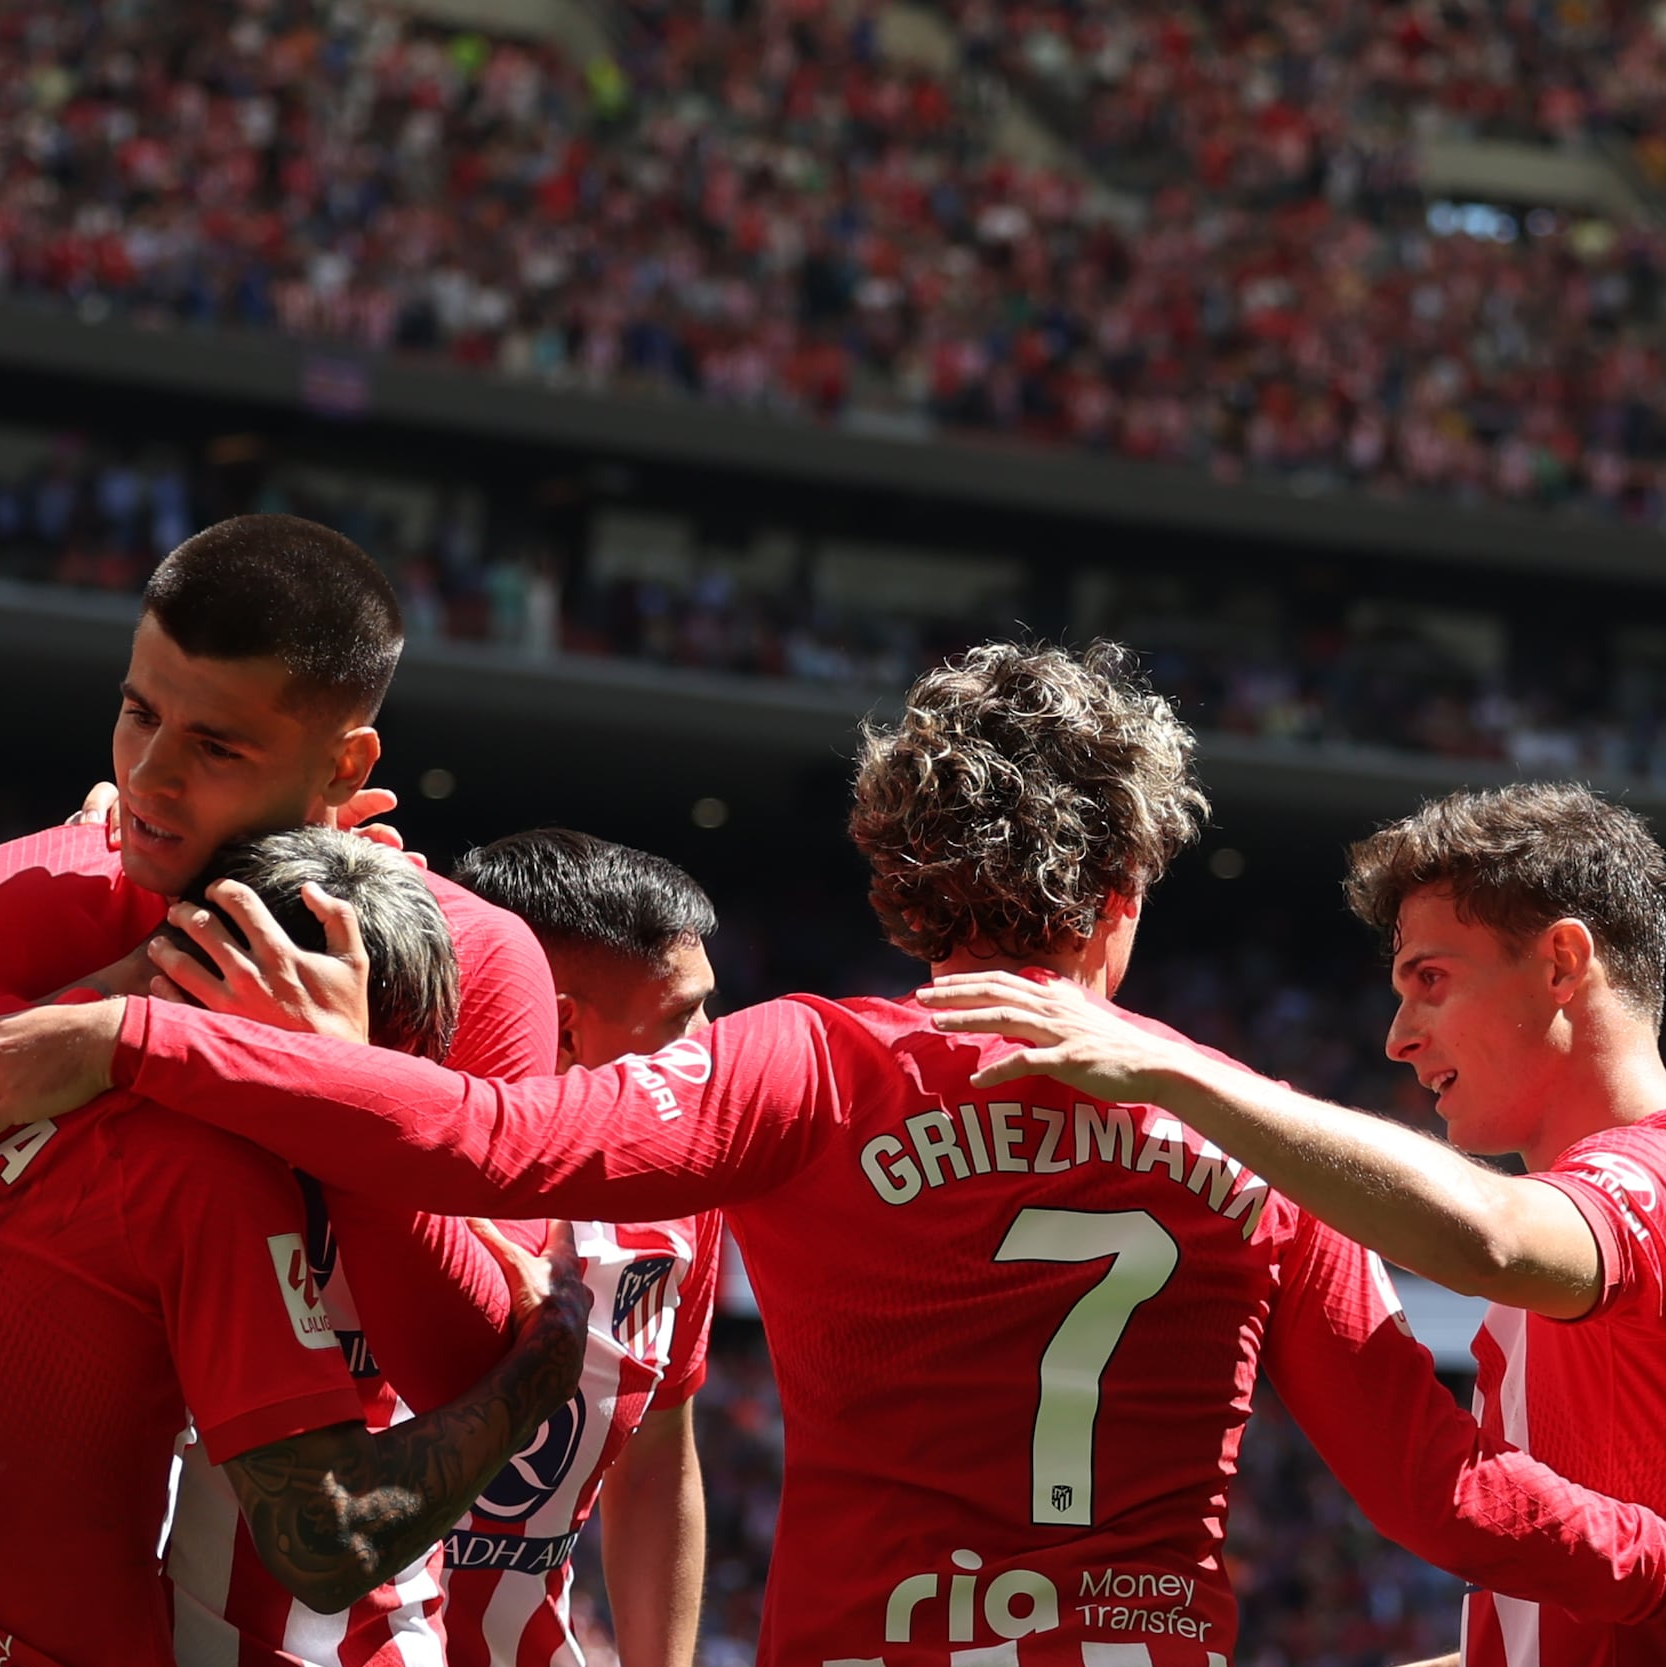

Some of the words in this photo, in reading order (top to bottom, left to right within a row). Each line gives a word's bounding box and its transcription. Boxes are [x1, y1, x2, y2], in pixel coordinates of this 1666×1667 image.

[299, 1314, 332, 1334] LALIG
[993, 1207, 1180, 1527] 7
[443, 1534, 524, 1568] ADH
[884, 1548, 1060, 1643] ria
[1078, 1569, 1196, 1611] Money
[1076, 1602, 1213, 1643] Transfer
